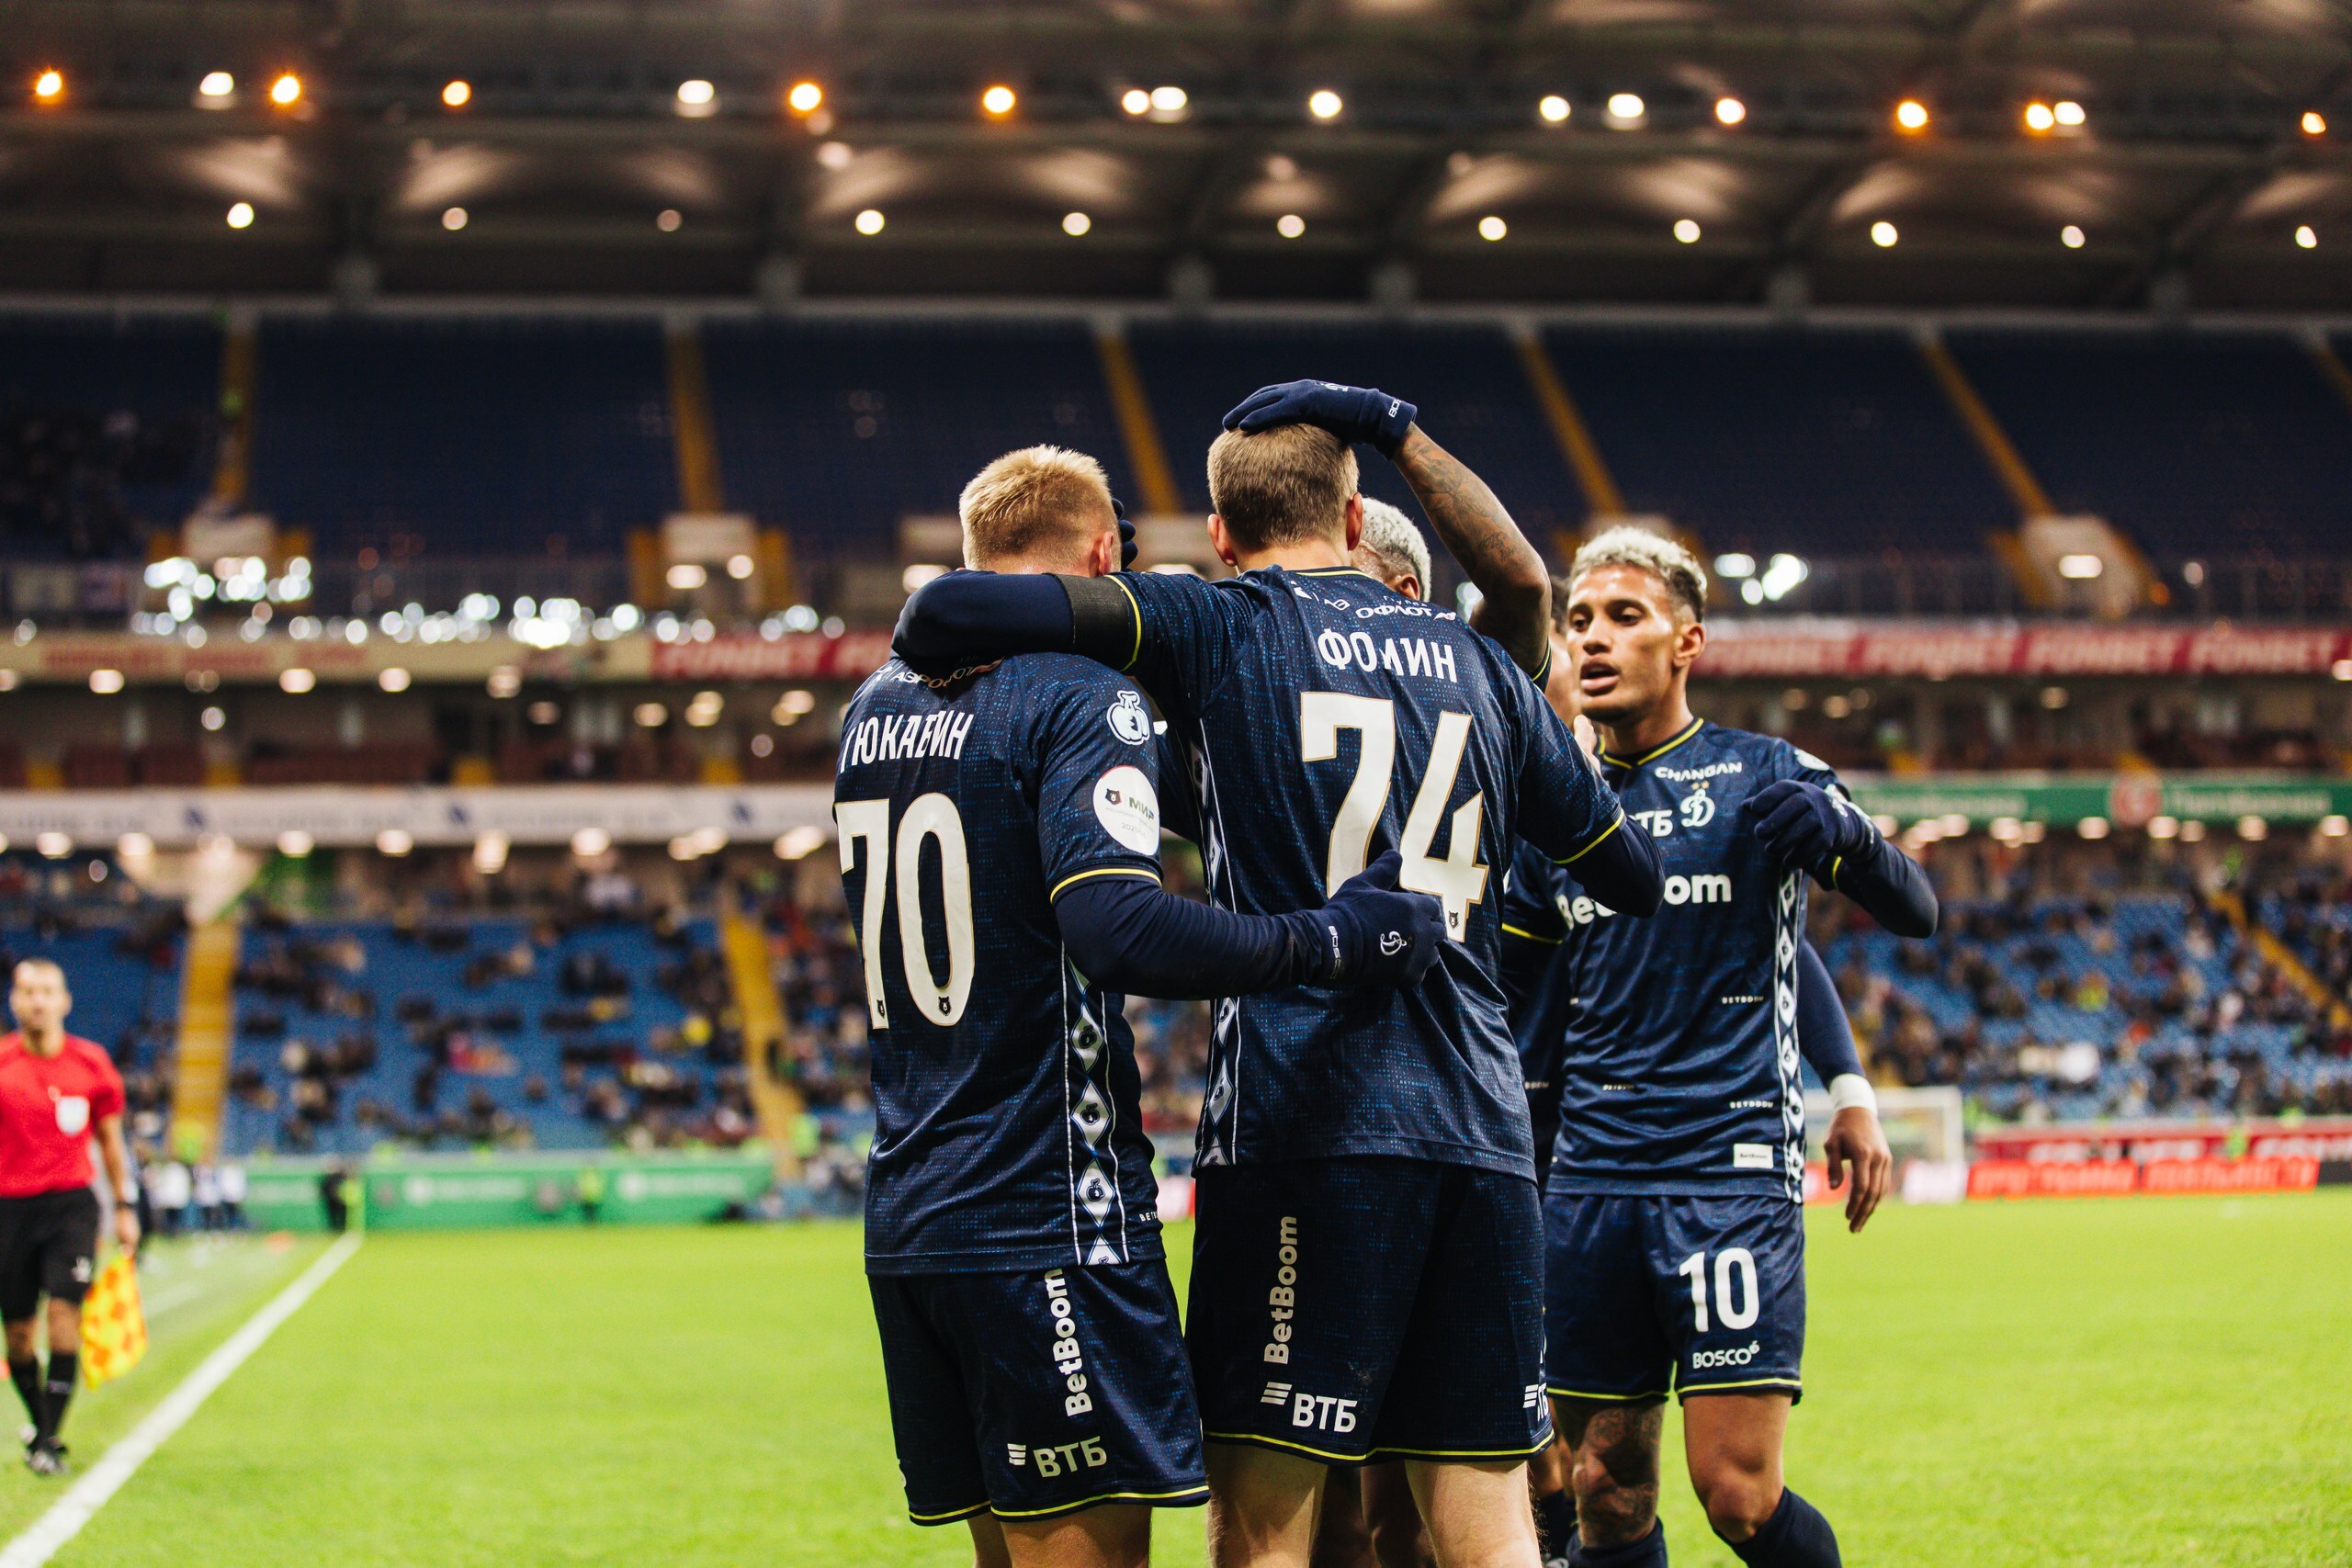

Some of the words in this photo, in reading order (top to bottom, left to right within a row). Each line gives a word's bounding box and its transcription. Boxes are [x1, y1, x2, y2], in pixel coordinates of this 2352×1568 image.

[1655, 761, 1742, 782] CHANGAN
[1300, 691, 1488, 942] 74
[1629, 809, 1673, 837] ТБ
[834, 792, 975, 1029] 70
[1264, 1215, 1297, 1365] BetBoom
[1679, 1247, 1760, 1332] 10
[1045, 1268, 1092, 1416] BetBoom
[1692, 1348, 1752, 1370] BOSCO
[1292, 1393, 1358, 1433] ВТБ
[1033, 1435, 1107, 1477] ВТБ
